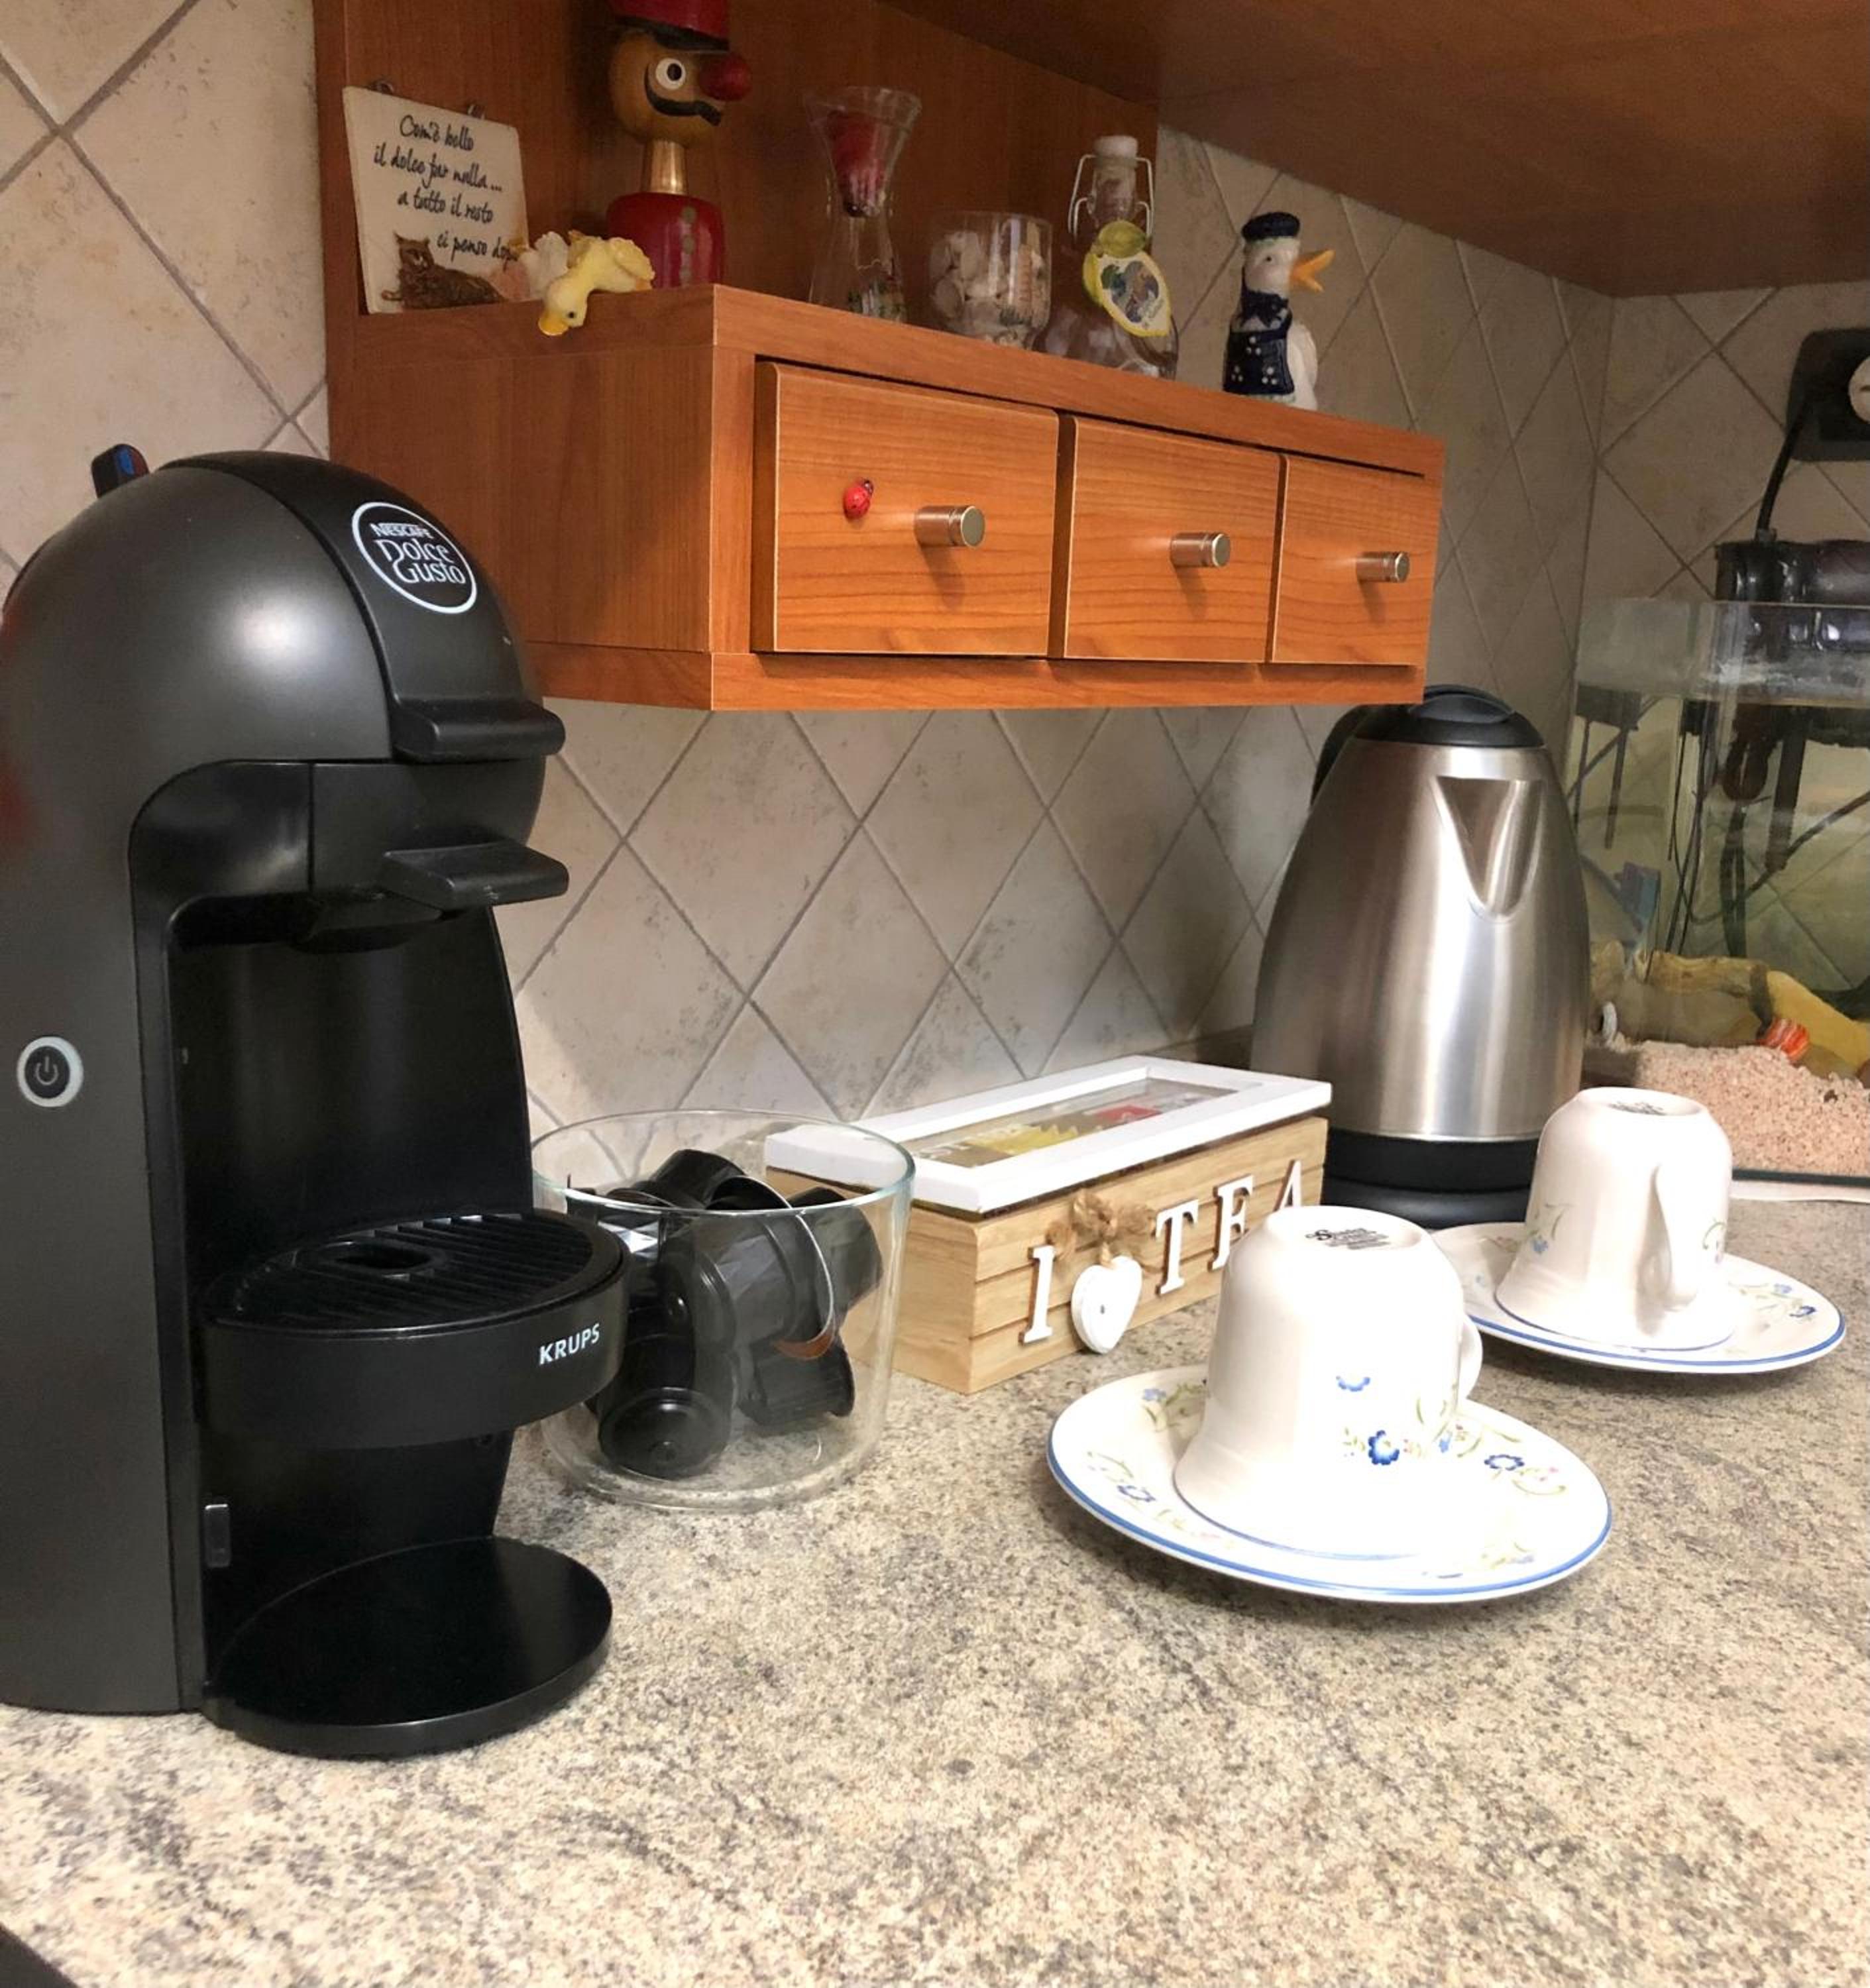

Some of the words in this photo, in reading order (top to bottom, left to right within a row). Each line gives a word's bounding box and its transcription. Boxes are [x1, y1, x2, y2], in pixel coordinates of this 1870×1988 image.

[445, 123, 474, 151] bello
[374, 142, 386, 166] il
[391, 145, 425, 174] dolce
[398, 191, 408, 206] a
[413, 186, 446, 213] tutto
[451, 192, 463, 217] il
[464, 201, 494, 224] resto
[437, 231, 449, 248] ci
[451, 237, 488, 262] penso
[374, 537, 455, 564] Dolce
[392, 559, 467, 584] Gusto
[1018, 1244, 1057, 1345] I
[539, 1323, 600, 1365] KRUPS
